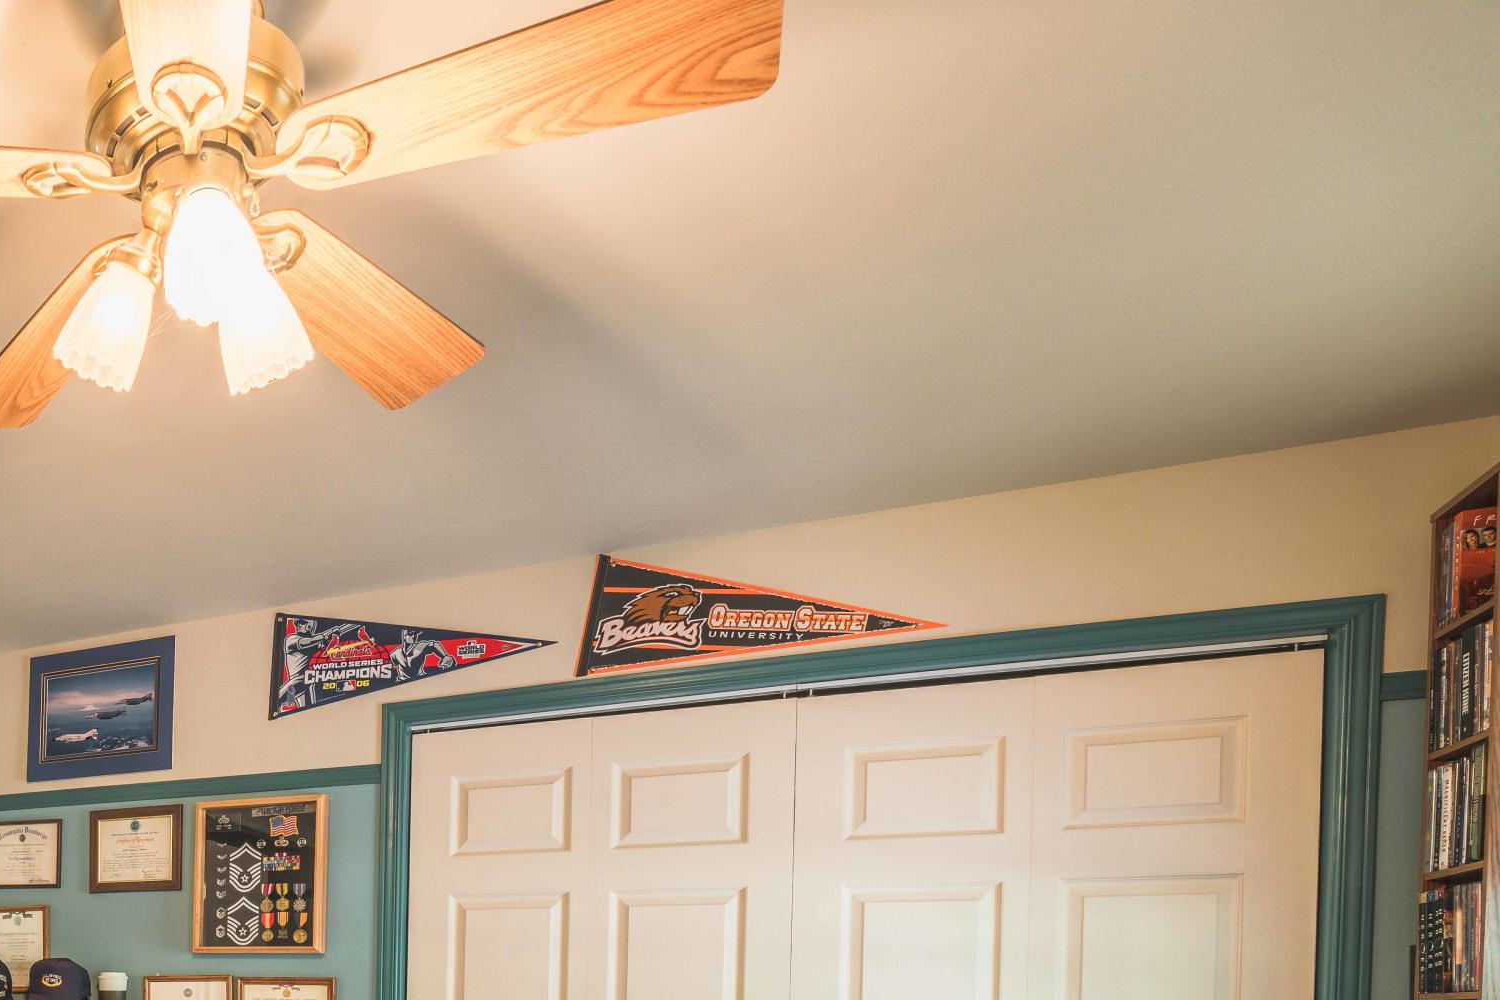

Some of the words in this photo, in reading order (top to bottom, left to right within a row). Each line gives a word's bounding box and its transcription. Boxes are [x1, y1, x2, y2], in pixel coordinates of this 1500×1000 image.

[708, 603, 795, 630] OREGON
[796, 605, 868, 632] STATE
[599, 617, 703, 648] Beavers
[708, 631, 805, 641] UNIVERSITY
[329, 646, 372, 660] Cardinals
[457, 644, 485, 652] WORLD
[312, 661, 347, 671] WORLD
[348, 658, 384, 668] SERIES
[304, 664, 395, 685] CHAMPIONS
[322, 681, 336, 690] 20
[356, 680, 370, 688] 06
